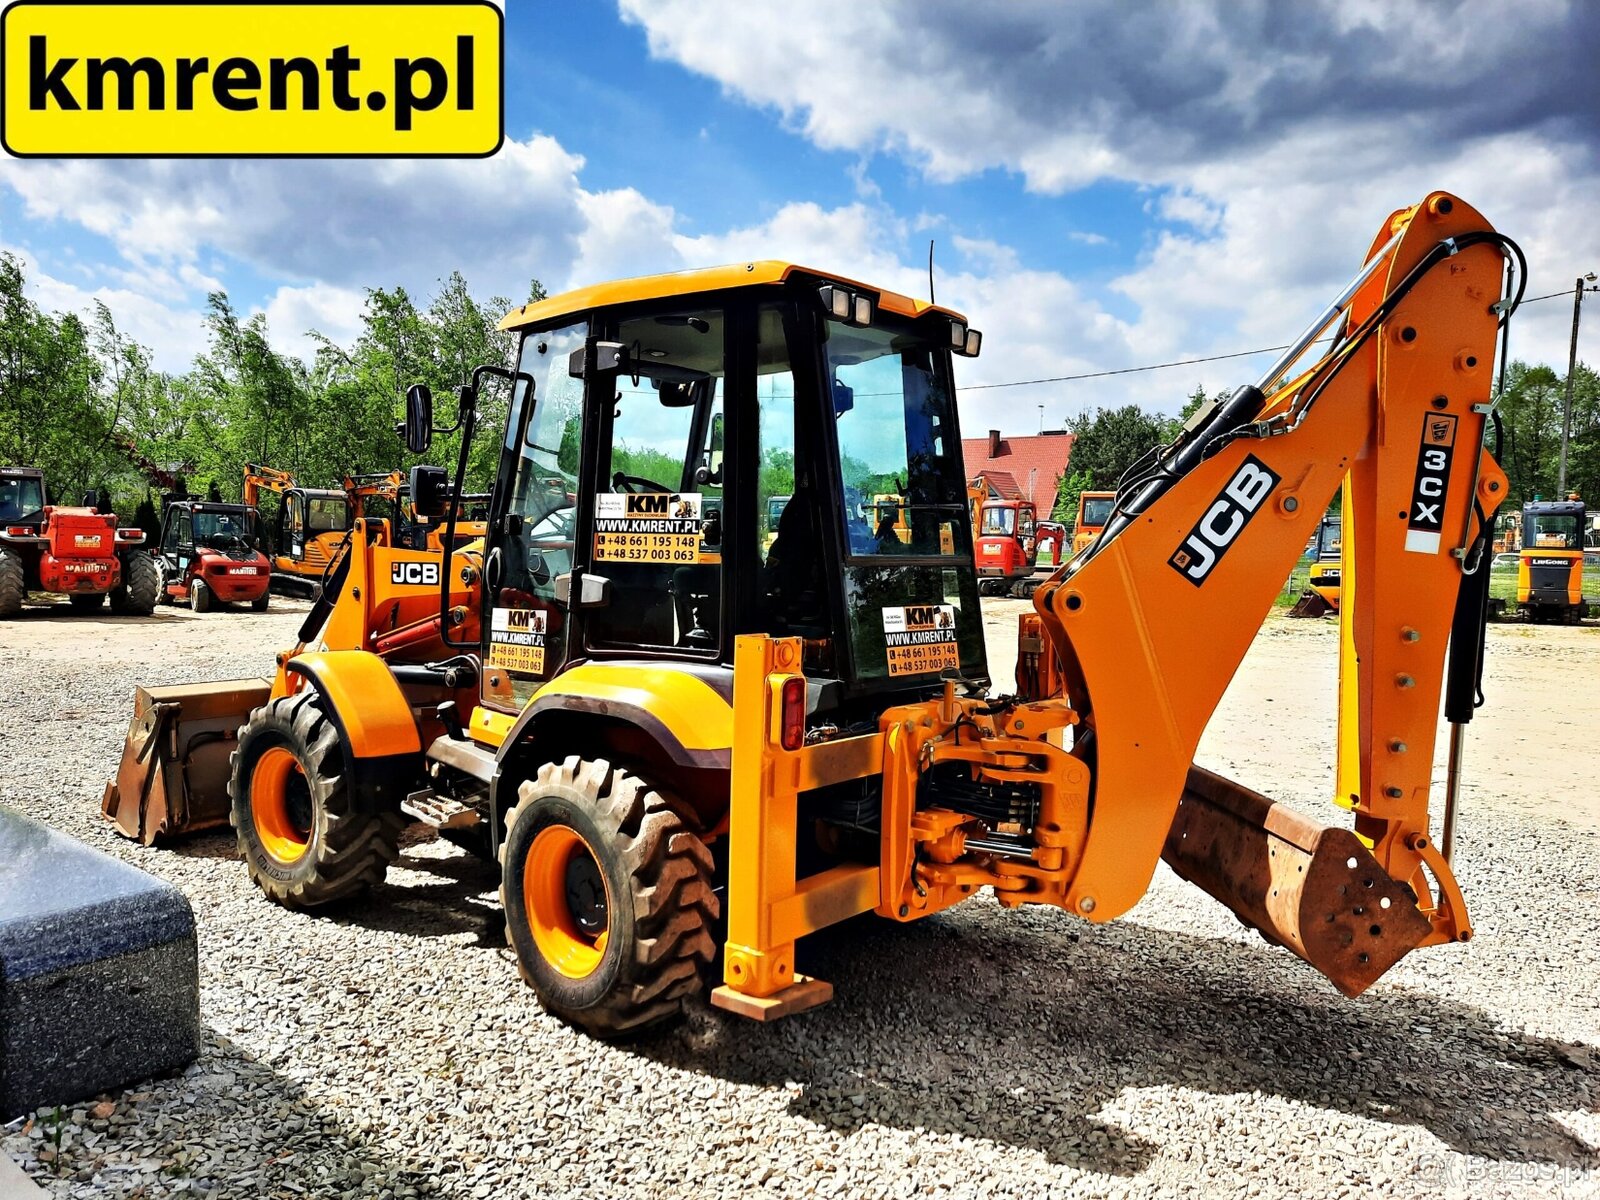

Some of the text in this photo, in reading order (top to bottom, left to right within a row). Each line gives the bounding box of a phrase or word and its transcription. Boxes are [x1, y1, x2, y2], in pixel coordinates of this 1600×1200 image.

[1414, 450, 1447, 524] 3CX
[627, 495, 668, 513] KM
[596, 519, 699, 533] WWW.KMRENT.PL
[1186, 462, 1273, 579] JCB
[607, 535, 695, 547] +48 661 195 148
[606, 548, 694, 560] +48 537 003 063
[392, 563, 438, 584] JCB
[508, 610, 529, 627] KM
[905, 607, 934, 625] KM
[491, 631, 545, 647] WWW.KMRENT.PL
[885, 629, 956, 646] WWW.KMRENT.PL
[508, 646, 518, 656] 661
[520, 647, 530, 658] 195
[531, 649, 542, 659] 148
[897, 644, 956, 659] +48 661 195 148
[507, 658, 517, 668] 537
[518, 660, 529, 670] 003
[530, 661, 541, 671] 063
[898, 657, 957, 672] +48 537 003 063
